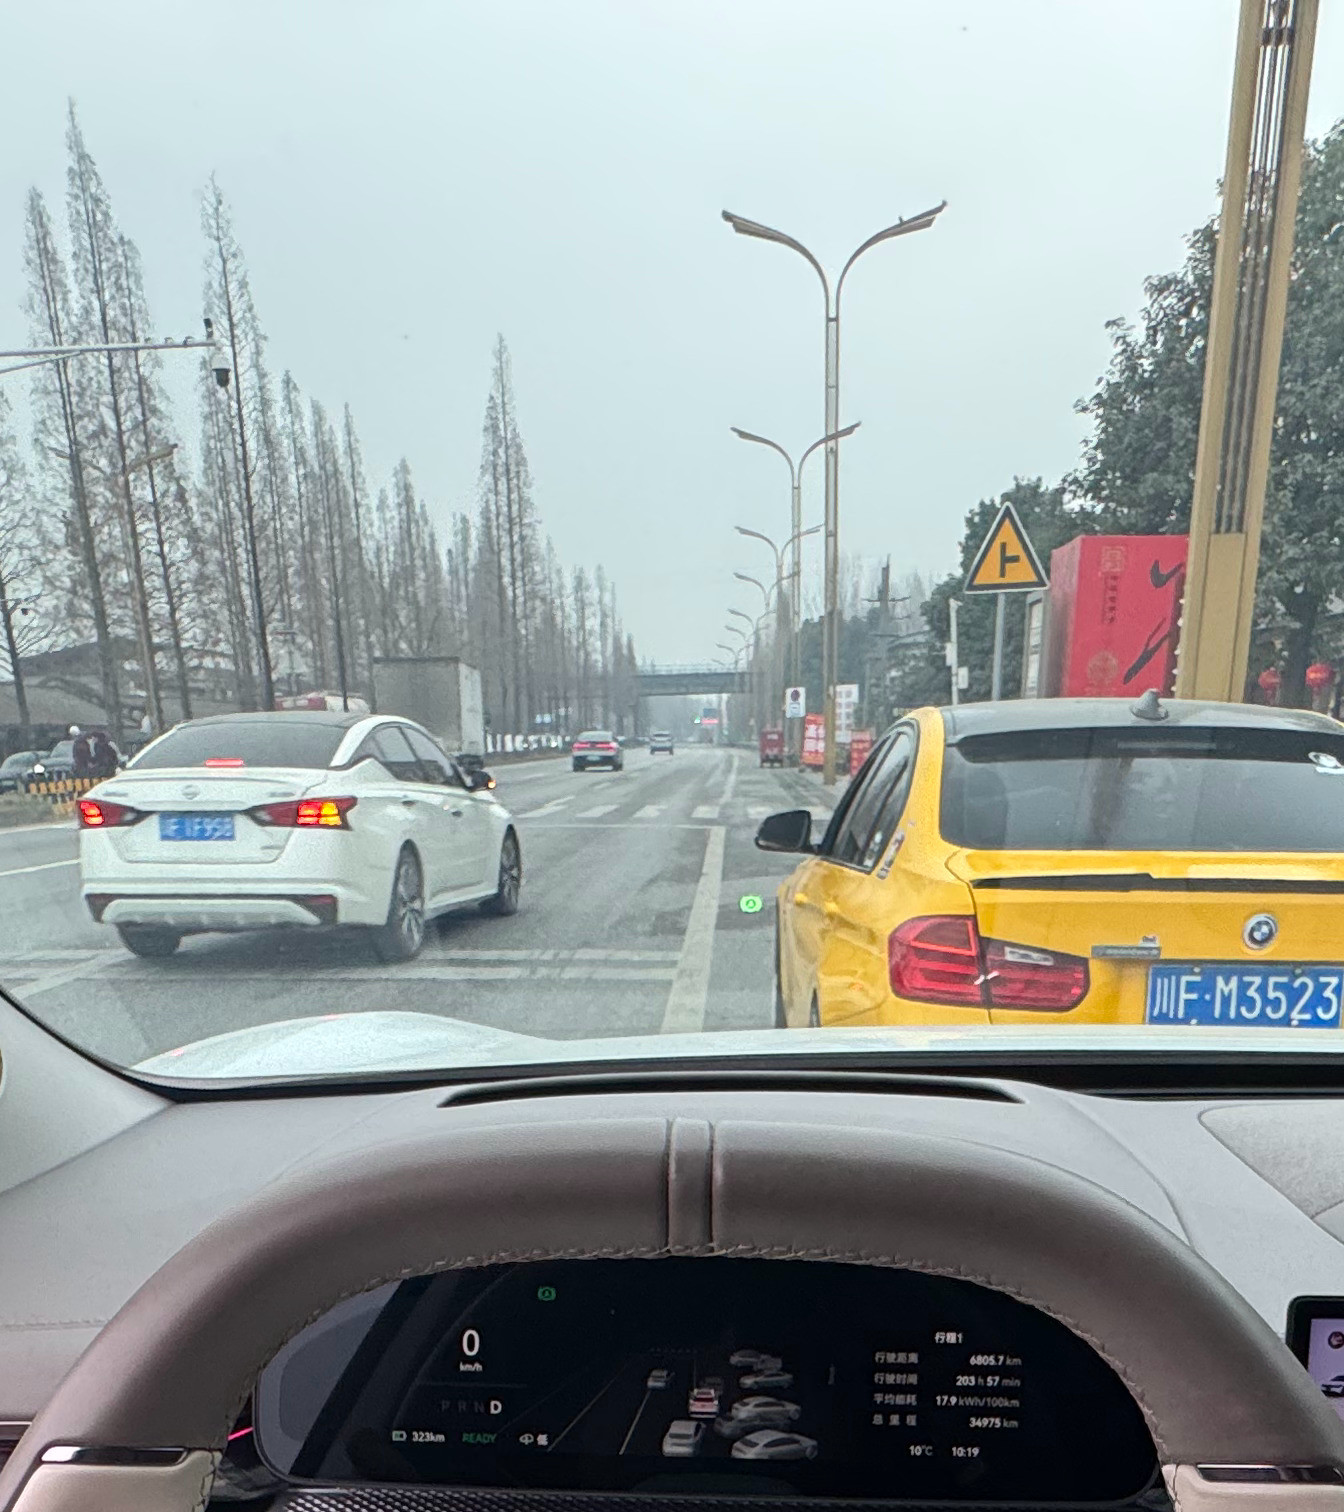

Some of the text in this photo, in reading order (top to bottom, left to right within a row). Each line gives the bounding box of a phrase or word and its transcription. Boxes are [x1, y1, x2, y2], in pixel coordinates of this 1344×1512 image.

[1152, 974, 1339, 1021] 川F·M3523
[462, 1329, 480, 1357] 0
[969, 1354, 1022, 1366] 6805.7 km
[459, 1361, 483, 1372] km/h
[955, 1375, 976, 1387] 203
[986, 1375, 1000, 1387] 57
[1001, 1376, 1021, 1387] min
[935, 1394, 958, 1407] 17.9
[490, 1400, 503, 1414] D
[968, 1417, 1019, 1429] 34975 km
[412, 1430, 446, 1443] 323km
[462, 1433, 497, 1444] READY
[951, 1446, 980, 1458] 10:19
